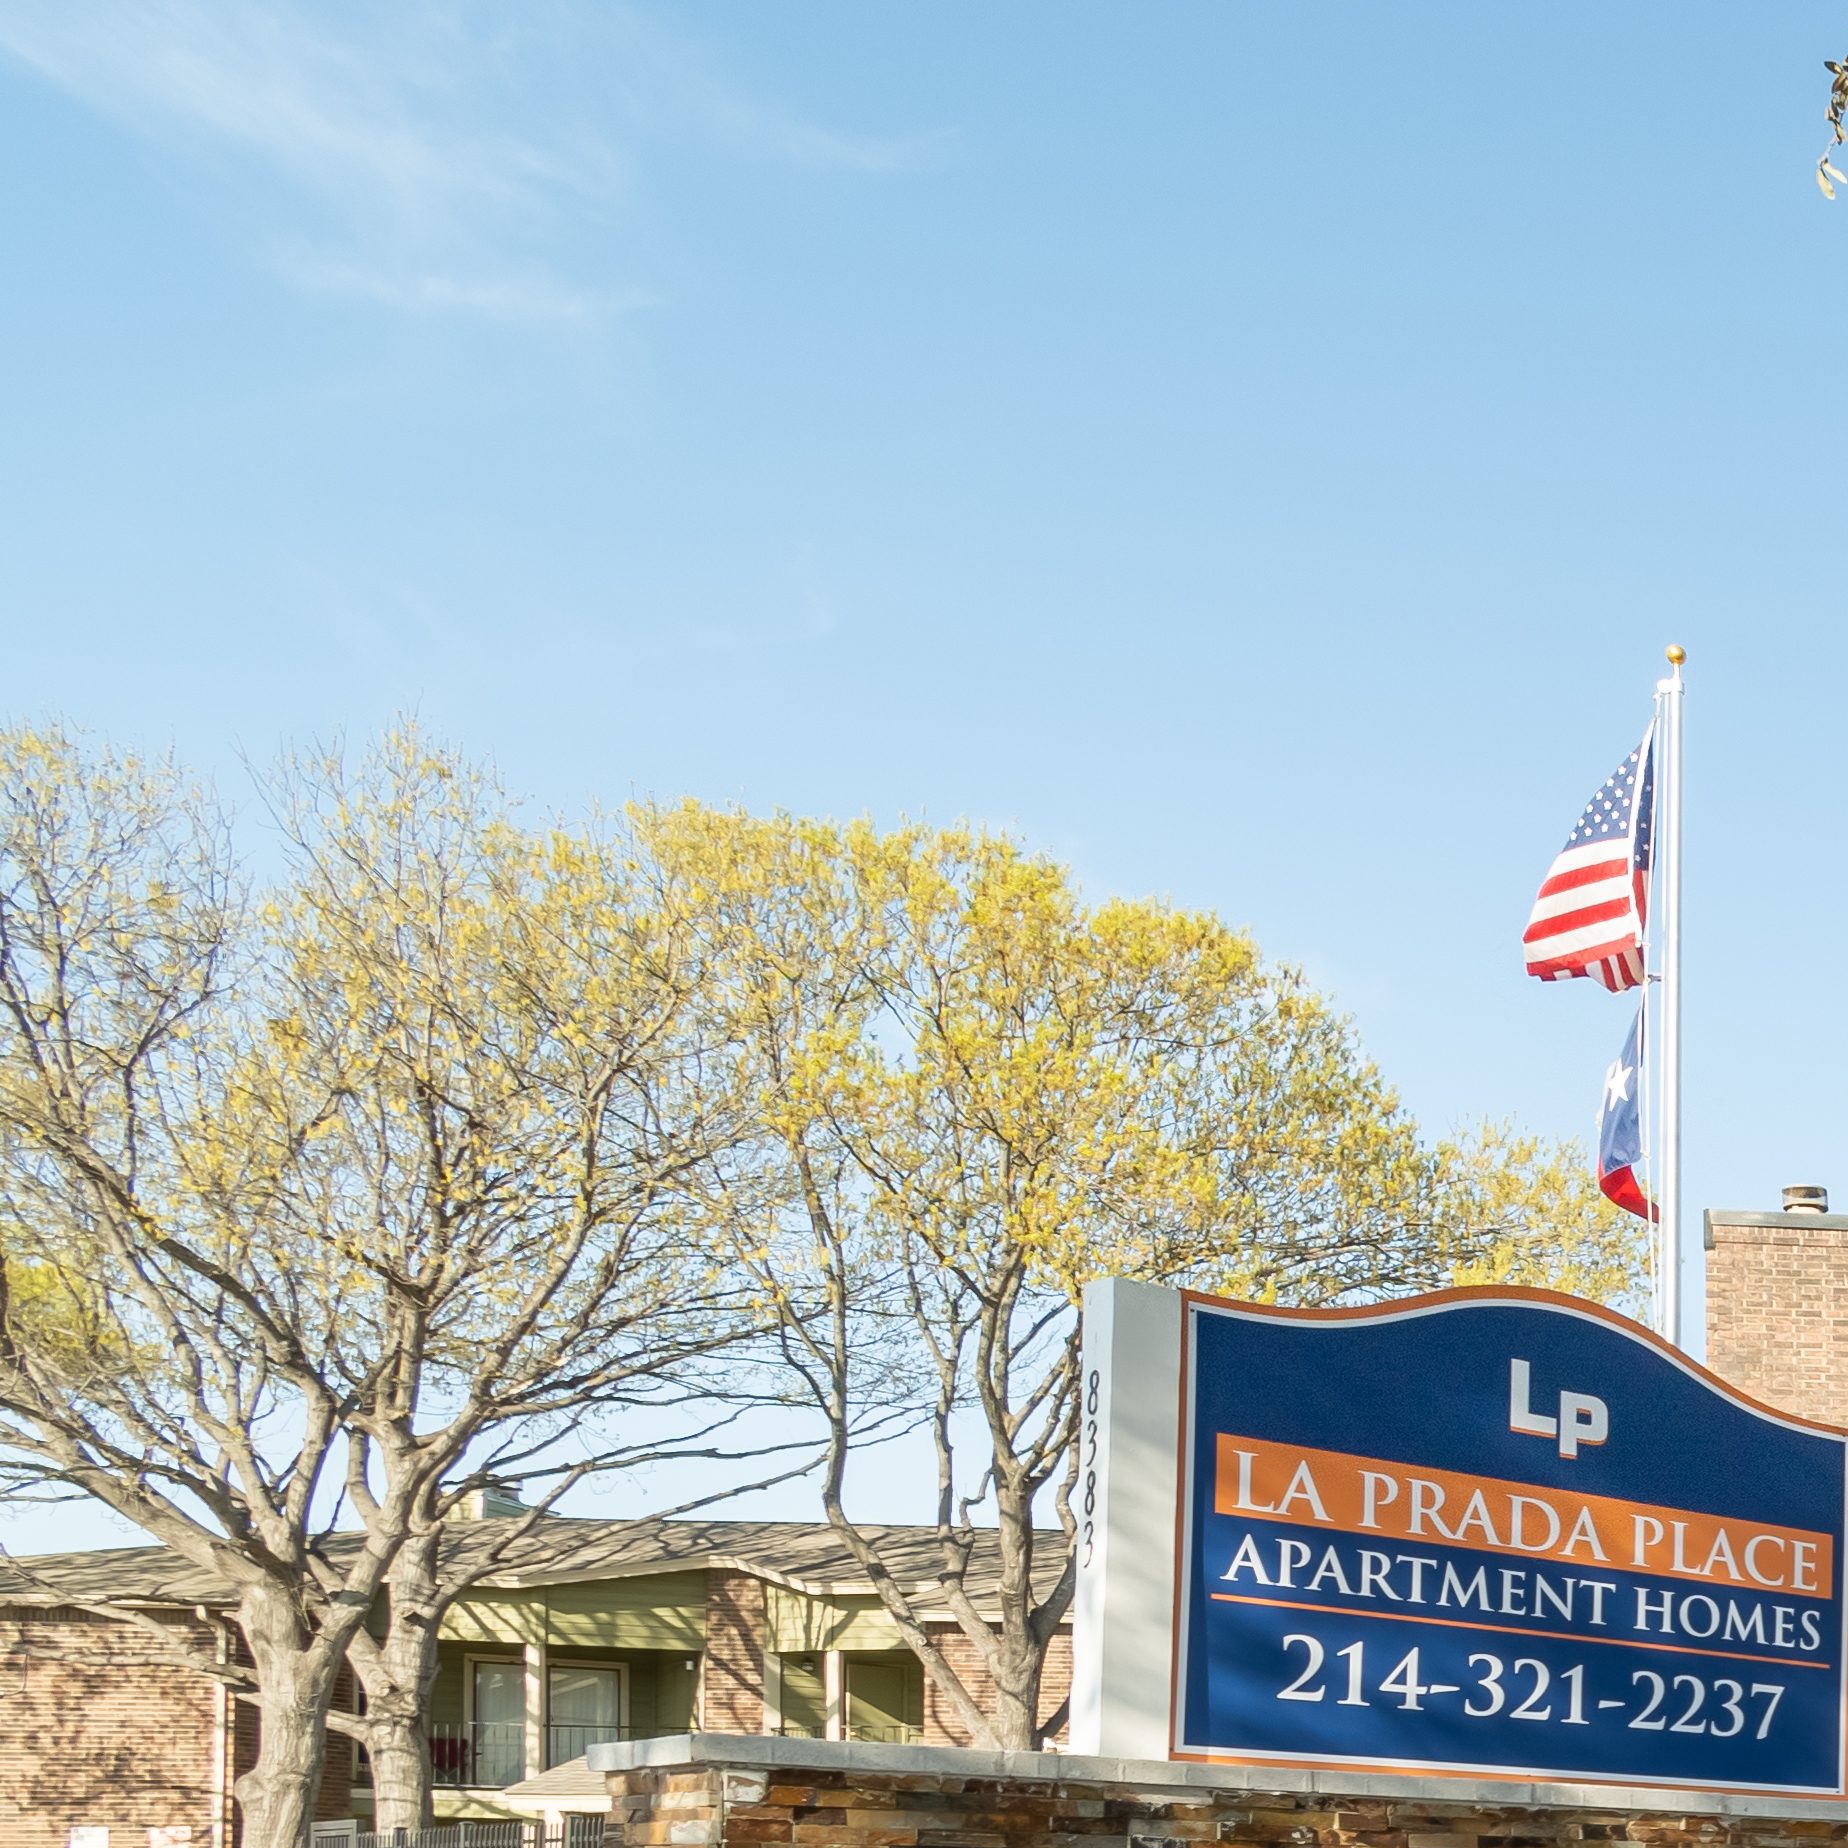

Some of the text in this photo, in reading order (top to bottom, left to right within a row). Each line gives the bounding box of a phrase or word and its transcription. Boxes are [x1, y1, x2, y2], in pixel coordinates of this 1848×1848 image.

[1083, 1369, 1101, 1569] 8383
[1231, 1450, 1819, 1592] LA PRADA PLACE
[1220, 1533, 1822, 1652] APARTMENT HOMES
[1276, 1633, 1786, 1740] 214-321-2237
